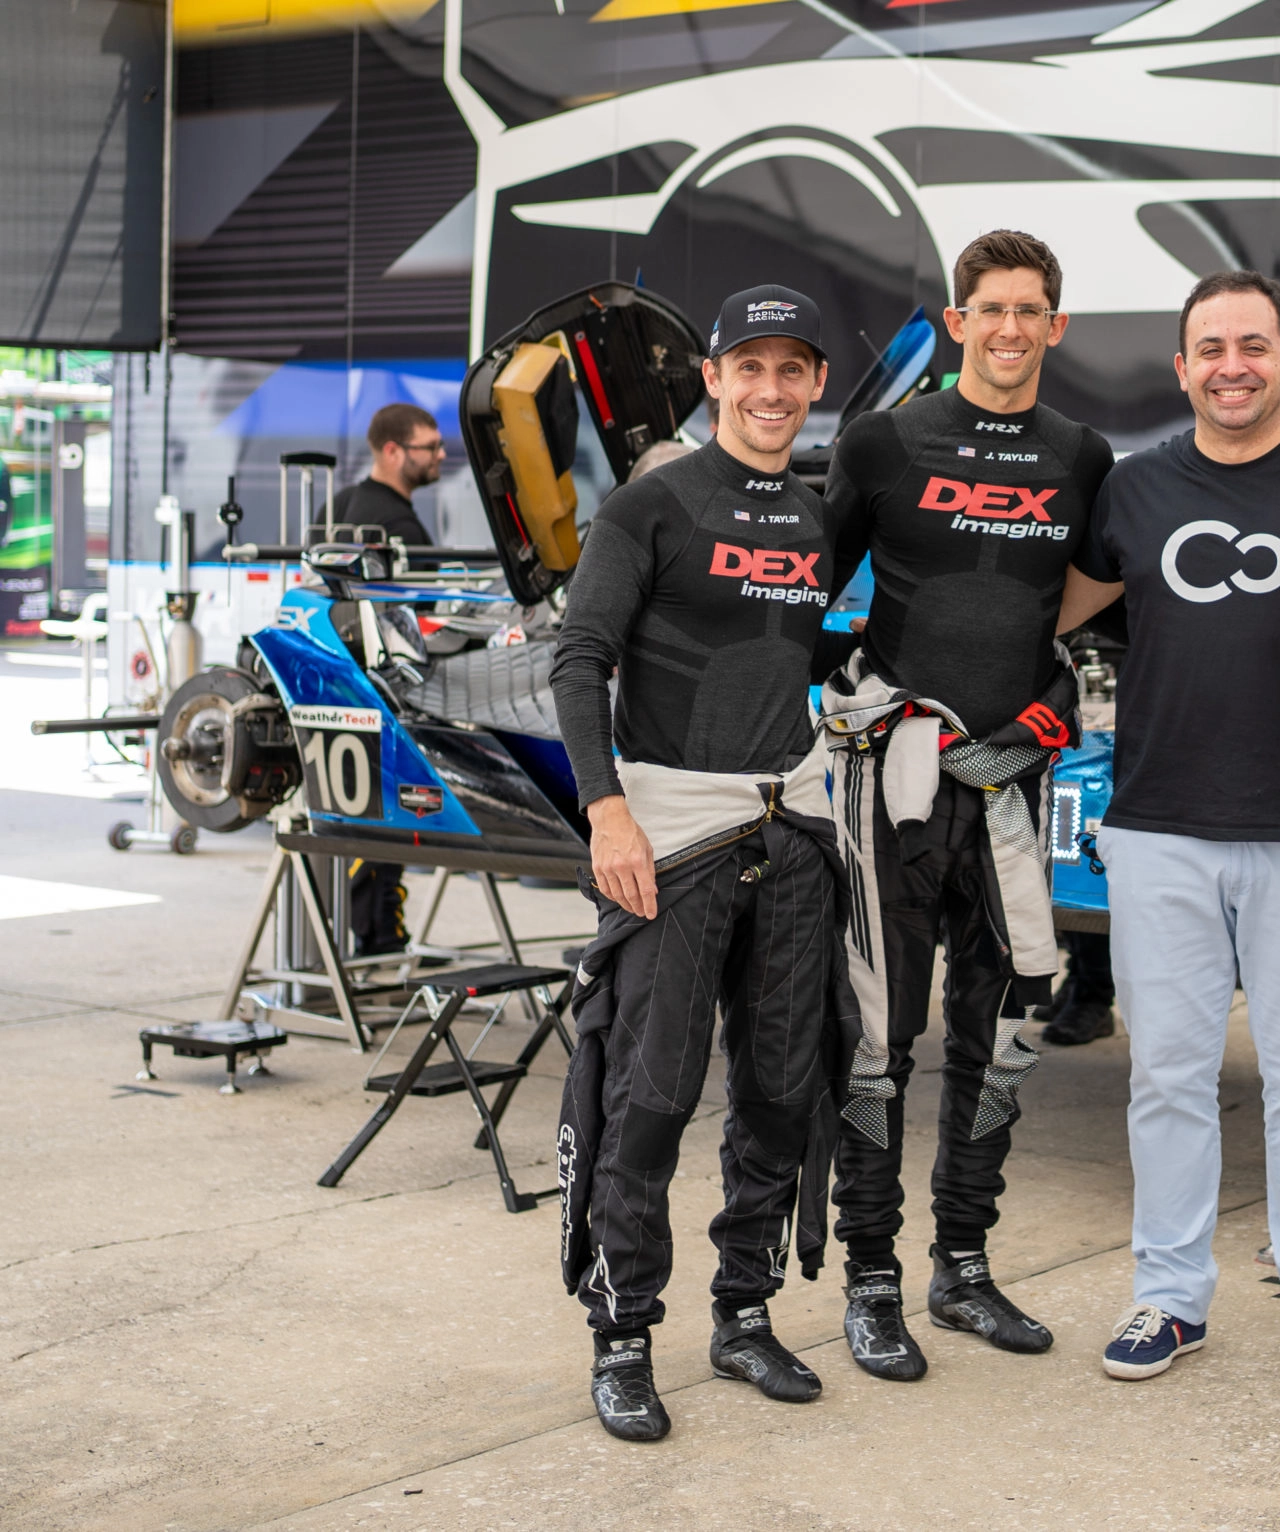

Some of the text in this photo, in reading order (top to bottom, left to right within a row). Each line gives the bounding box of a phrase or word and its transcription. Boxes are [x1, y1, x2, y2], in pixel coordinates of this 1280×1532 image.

[747, 310, 797, 319] CADILLAC
[747, 315, 785, 323] RACING
[975, 421, 1024, 434] HRX
[984, 452, 1038, 462] J. TAYLOR
[745, 480, 784, 491] HRX
[918, 476, 1059, 521] DEX
[768, 515, 799, 523] TAYLOR
[951, 514, 1070, 540] imaging
[709, 541, 820, 587] DEX
[741, 580, 829, 607] imaging
[304, 731, 371, 817] 10
